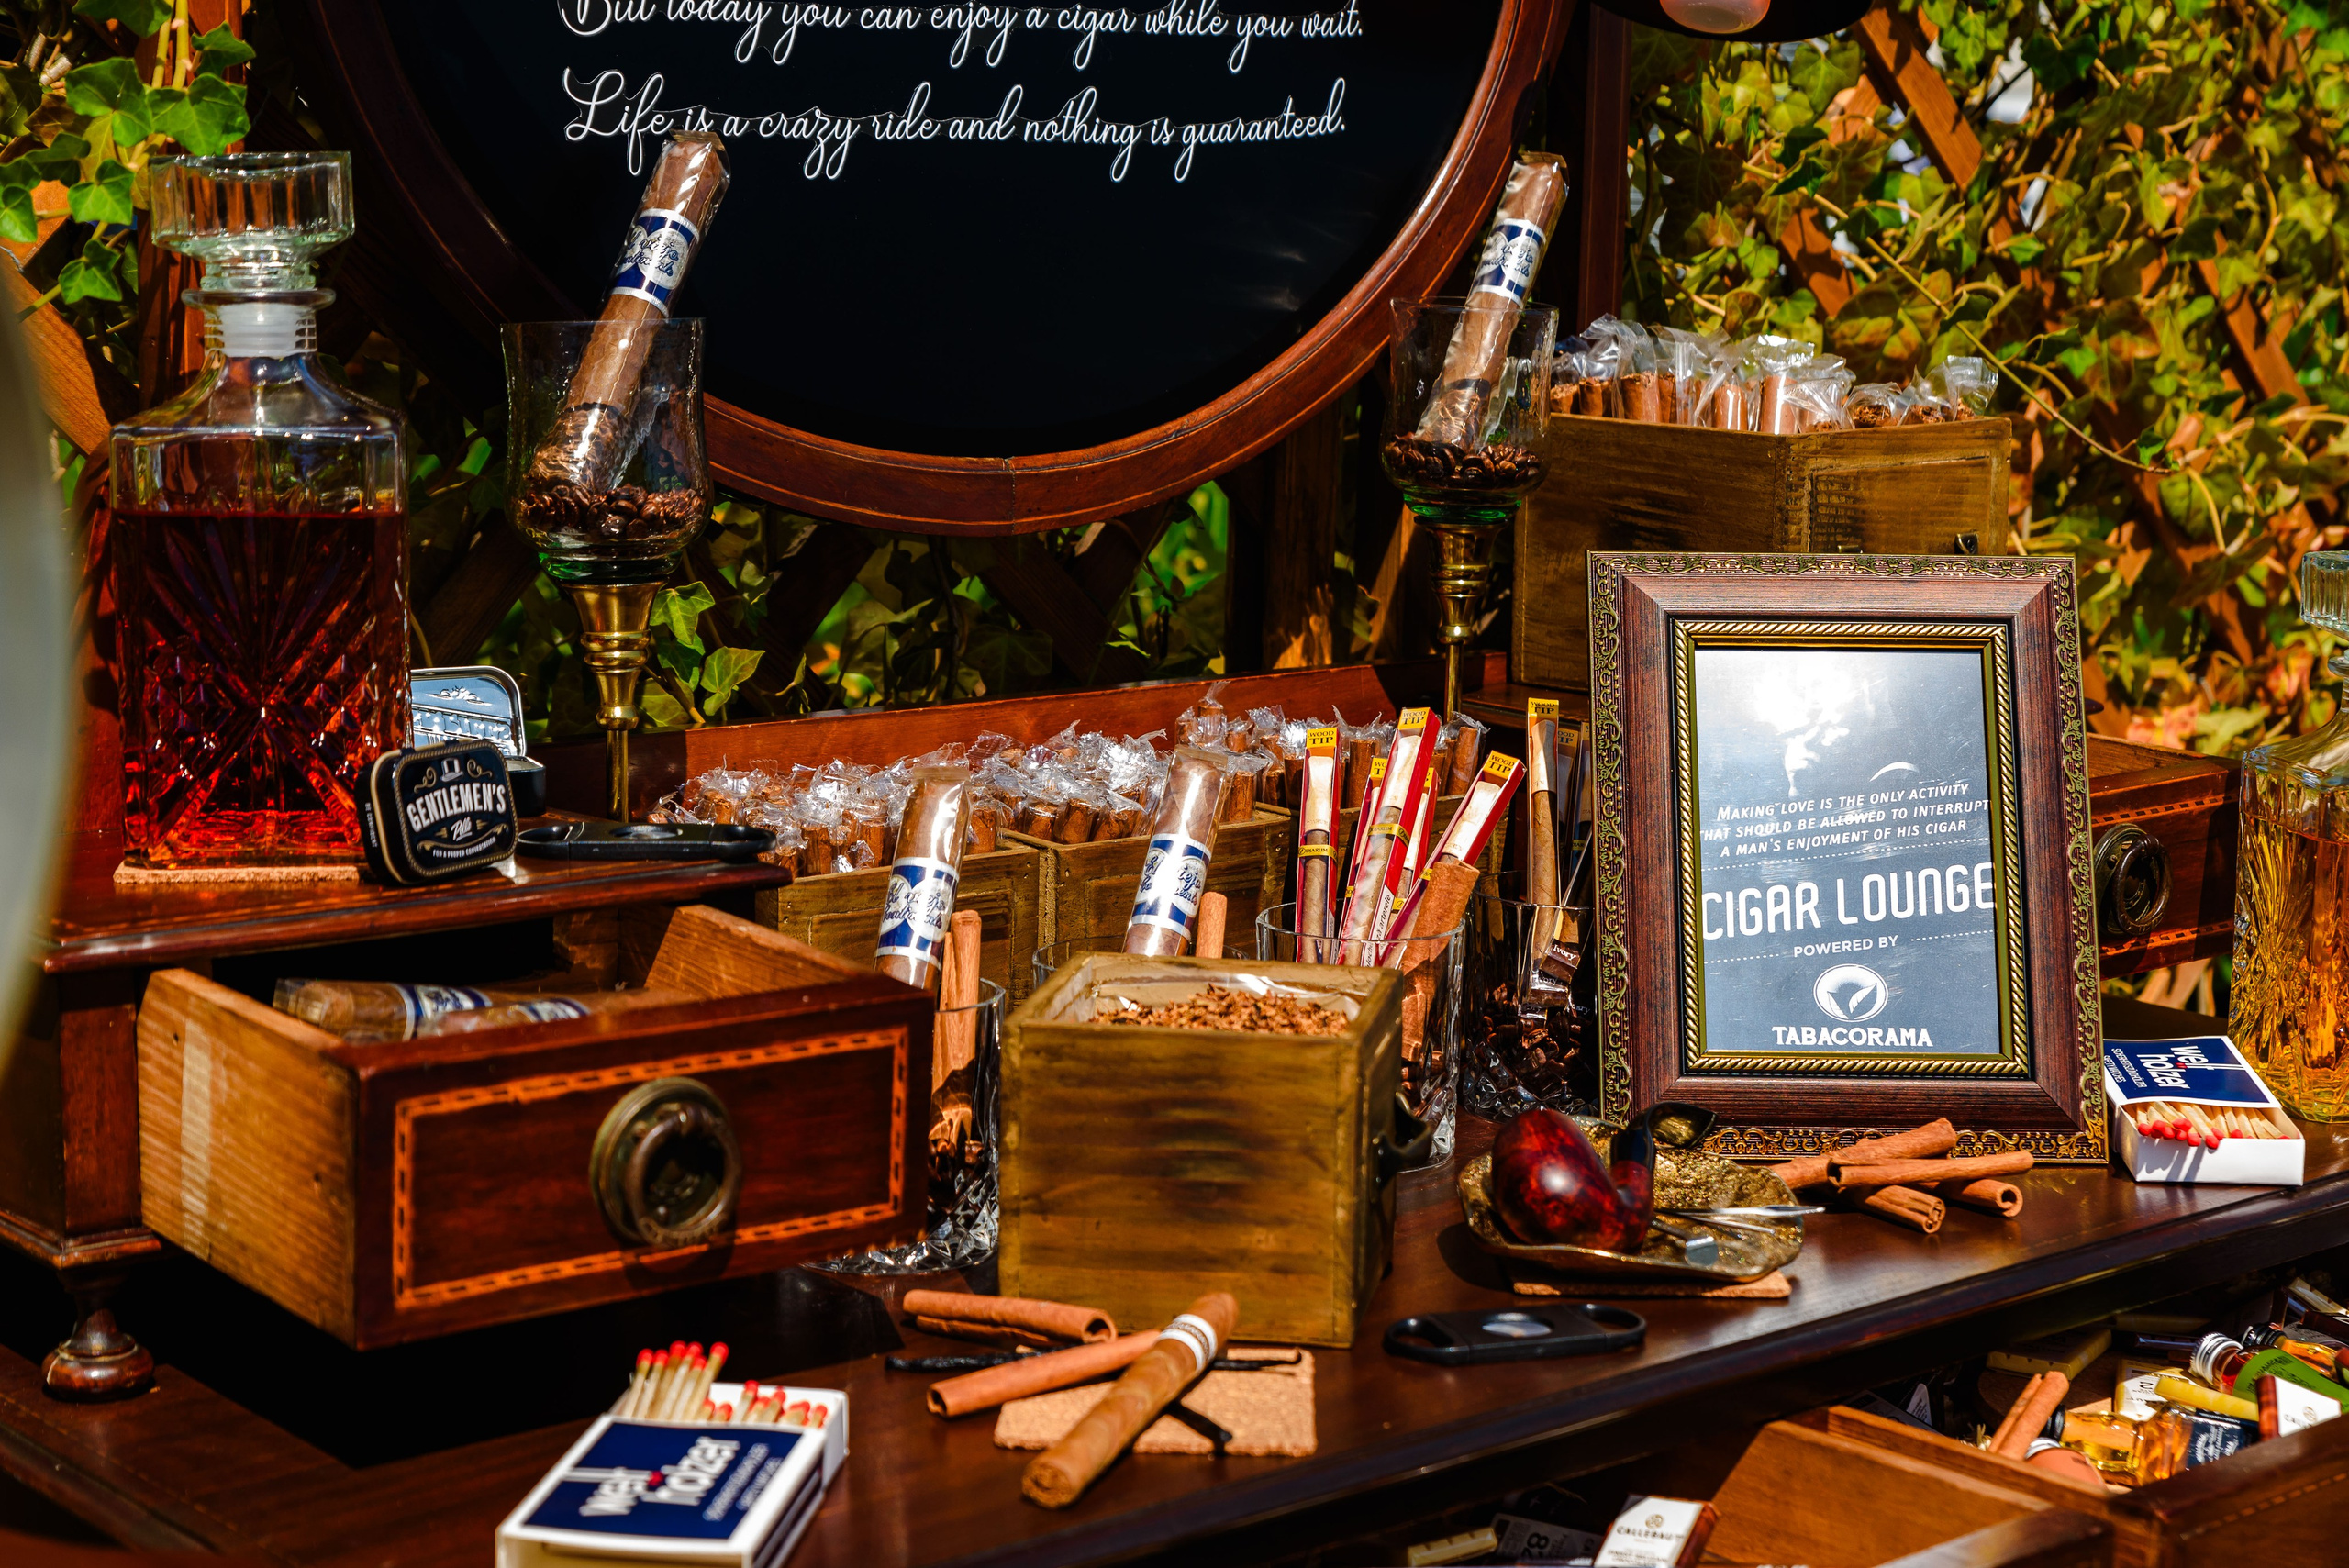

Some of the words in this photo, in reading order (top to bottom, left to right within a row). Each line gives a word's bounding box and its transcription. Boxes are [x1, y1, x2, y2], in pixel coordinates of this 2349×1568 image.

[773, 2, 850, 64] you
[861, 6, 921, 29] can
[930, 1, 1019, 68] enjoy
[1026, 8, 1049, 28] a
[1058, 4, 1136, 70] cigar
[1145, 0, 1228, 36] while
[1228, 15, 1293, 72] you
[1301, 0, 1363, 37] wait.
[563, 67, 674, 175] Life
[685, 107, 714, 133] is
[723, 116, 750, 139] a
[759, 109, 860, 179] crazy
[872, 82, 941, 139] ride
[949, 84, 1023, 140] and
[1023, 87, 1142, 182] nothing
[1150, 117, 1175, 145] is
[1174, 78, 1346, 182] guaranteed.
[1402, 717, 1424, 725] TIP
[1488, 761, 1511, 773] TIP
[1491, 755, 1515, 766] WOOD
[406, 782, 506, 833] GENTLEMEN'S
[1717, 805, 1775, 822] MAKING
[1781, 800, 1815, 815] LOVE
[1820, 797, 1833, 810] IS
[1839, 795, 1865, 807] THE
[1869, 790, 1905, 805] ONLY
[1909, 784, 1969, 801] ACTIVITY
[1735, 820, 1792, 838] SHOULD
[1798, 817, 1816, 831] BE
[1820, 810, 1886, 828] ALLOWED
[1891, 808, 1908, 820] TO
[1913, 799, 1990, 818] INTERRUPT
[433, 849, 442, 858] FOR
[1720, 846, 1730, 858] A
[1735, 838, 1781, 856] MAN'S
[1787, 829, 1869, 851] ENJOYMENT
[1874, 828, 1891, 840] OF
[1897, 825, 1920, 839] HIS
[1925, 820, 1966, 835] CIGAR
[1378, 894, 1391, 929] arterele
[1702, 882, 1821, 940] CIGAR
[1837, 862, 1995, 925] LOUNGE
[1553, 944, 1577, 961] Ivory
[1794, 938, 1873, 958] POWERED
[1878, 935, 1898, 949] BY
[1772, 1026, 1933, 1047] TABACORAMA
